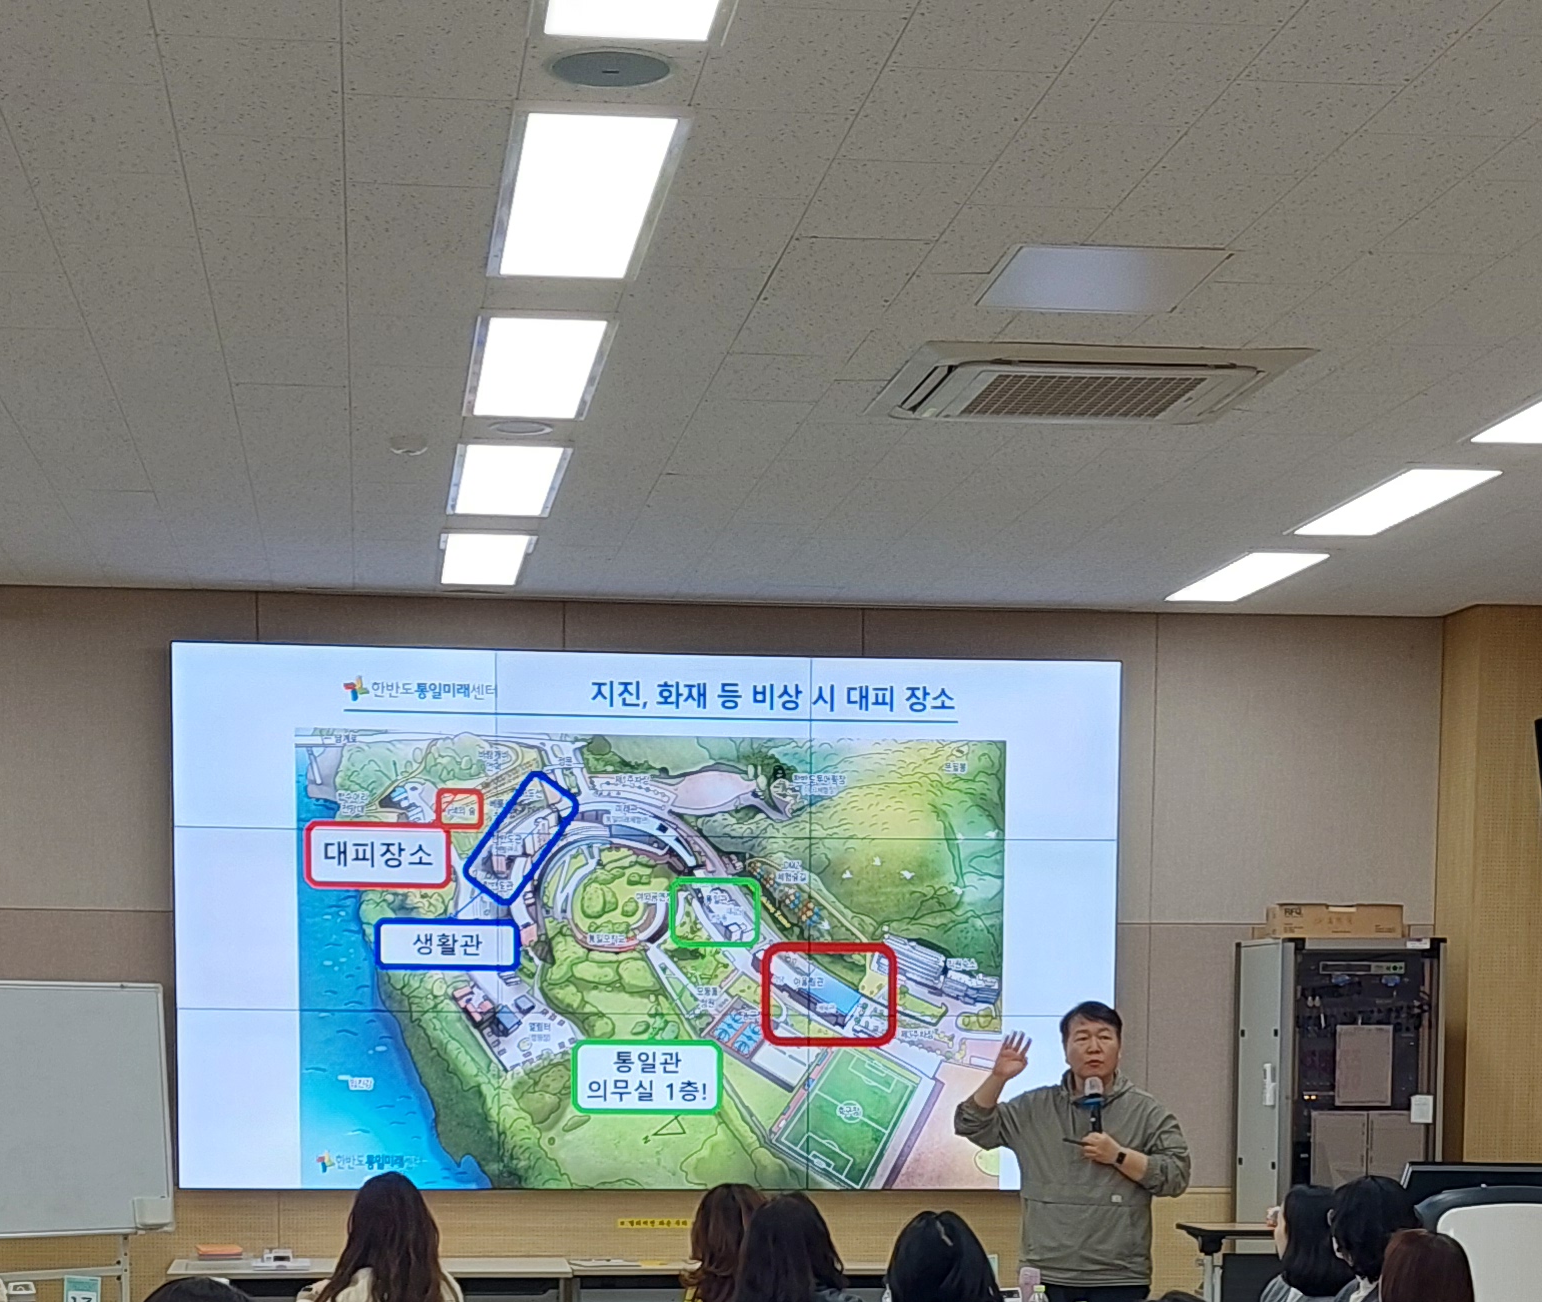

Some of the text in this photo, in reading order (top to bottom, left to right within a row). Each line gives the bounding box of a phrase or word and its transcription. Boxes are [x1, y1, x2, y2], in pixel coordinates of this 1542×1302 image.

[372, 680, 497, 700] 한반도통일미래센터
[590, 680, 956, 712] 지진, 화재 등 비상 시 대피 장소
[323, 841, 434, 868] 대피장소
[412, 933, 483, 956] 생활관
[613, 1051, 682, 1074] 통일관
[587, 1079, 707, 1102] 의무실 1층!
